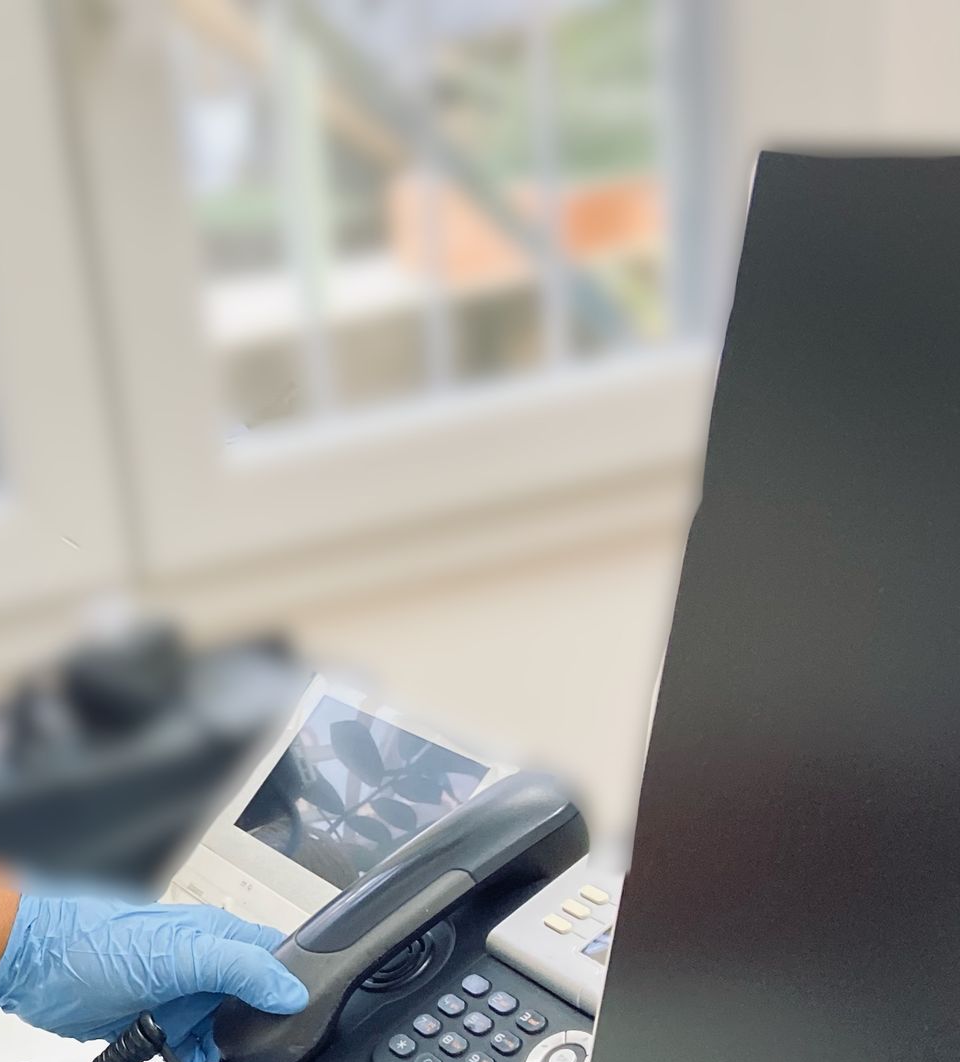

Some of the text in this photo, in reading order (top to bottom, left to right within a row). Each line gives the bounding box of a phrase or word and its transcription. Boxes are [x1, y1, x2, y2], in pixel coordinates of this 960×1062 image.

[519, 1011, 532, 1022] 3
[442, 1034, 455, 1045] 8
[493, 1033, 506, 1043] 6
